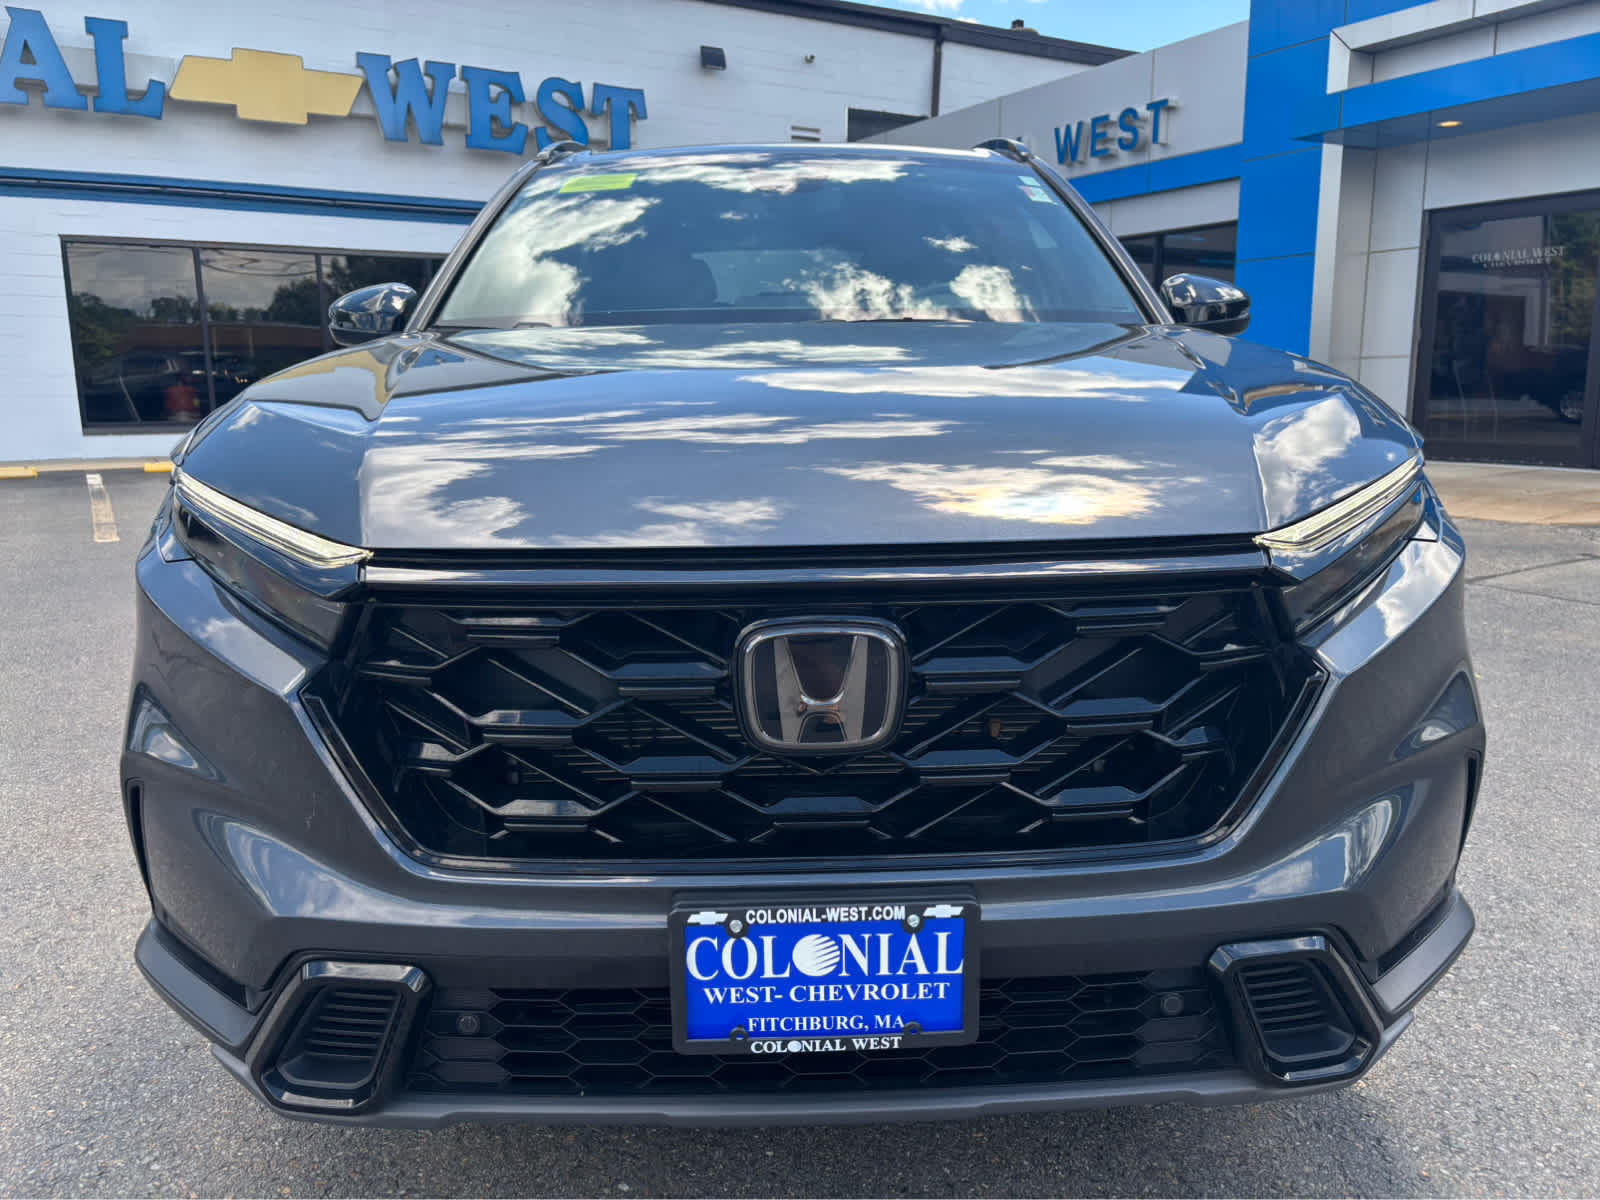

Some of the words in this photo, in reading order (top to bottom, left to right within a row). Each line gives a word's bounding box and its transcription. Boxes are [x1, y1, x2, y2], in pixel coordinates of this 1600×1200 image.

[356, 51, 648, 155] WEST
[1054, 98, 1170, 165] WEST
[745, 905, 906, 924] COLONIAL-WEST.COM
[686, 932, 964, 980] COLONIAL
[789, 982, 950, 1001] CHEVROLET
[748, 1015, 869, 1032] FITCHBURG,
[874, 1014, 905, 1029] MA
[750, 1039, 846, 1054] COLONIAL
[852, 1036, 902, 1050] WEST
